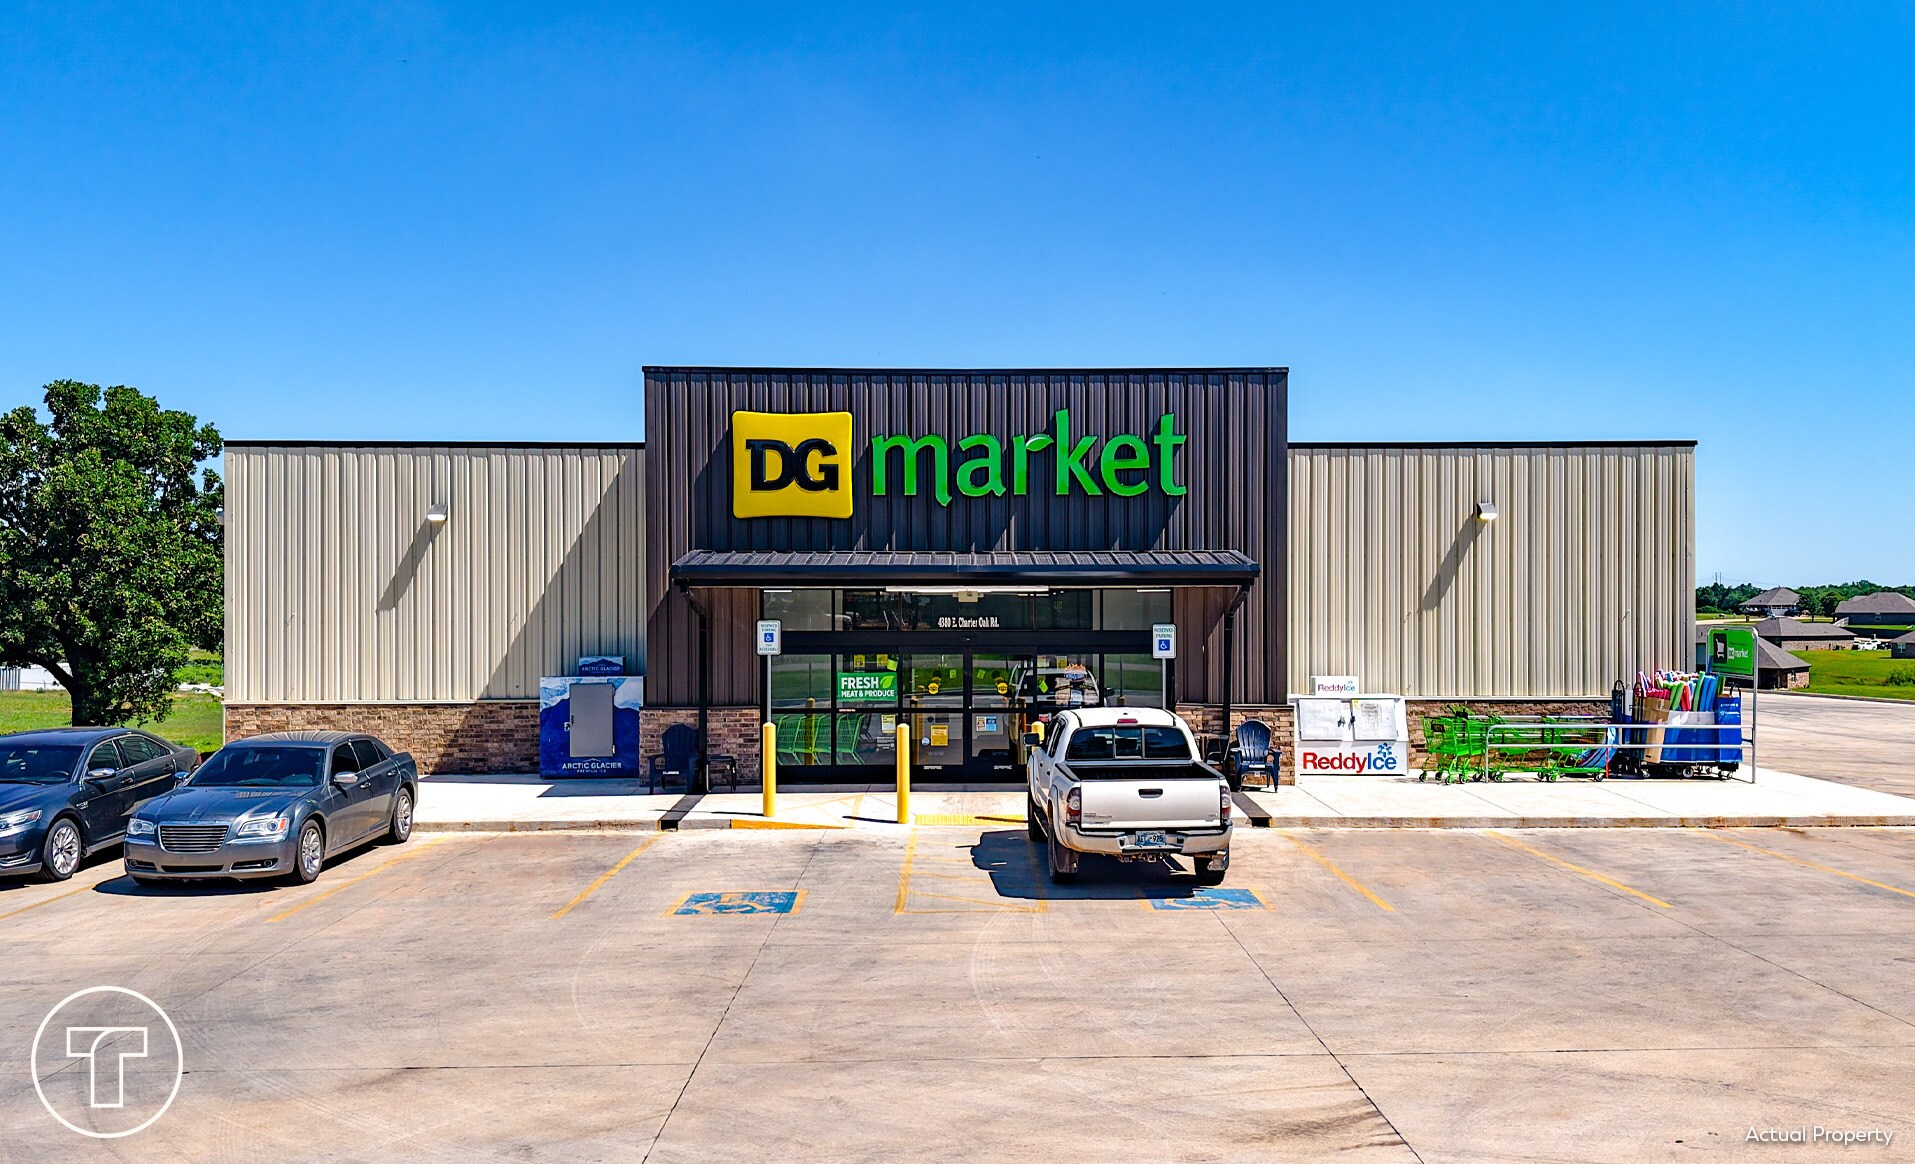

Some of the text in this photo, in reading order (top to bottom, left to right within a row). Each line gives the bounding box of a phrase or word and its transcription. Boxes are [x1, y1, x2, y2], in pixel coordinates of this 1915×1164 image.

[745, 408, 1188, 507] DG market
[978, 616, 989, 628] Oak
[990, 616, 1000, 628] Rd.
[841, 676, 879, 689] FRESH
[841, 690, 858, 698] MEAT
[864, 689, 895, 698] PRODUCE
[1302, 752, 1397, 773] ReddyIce
